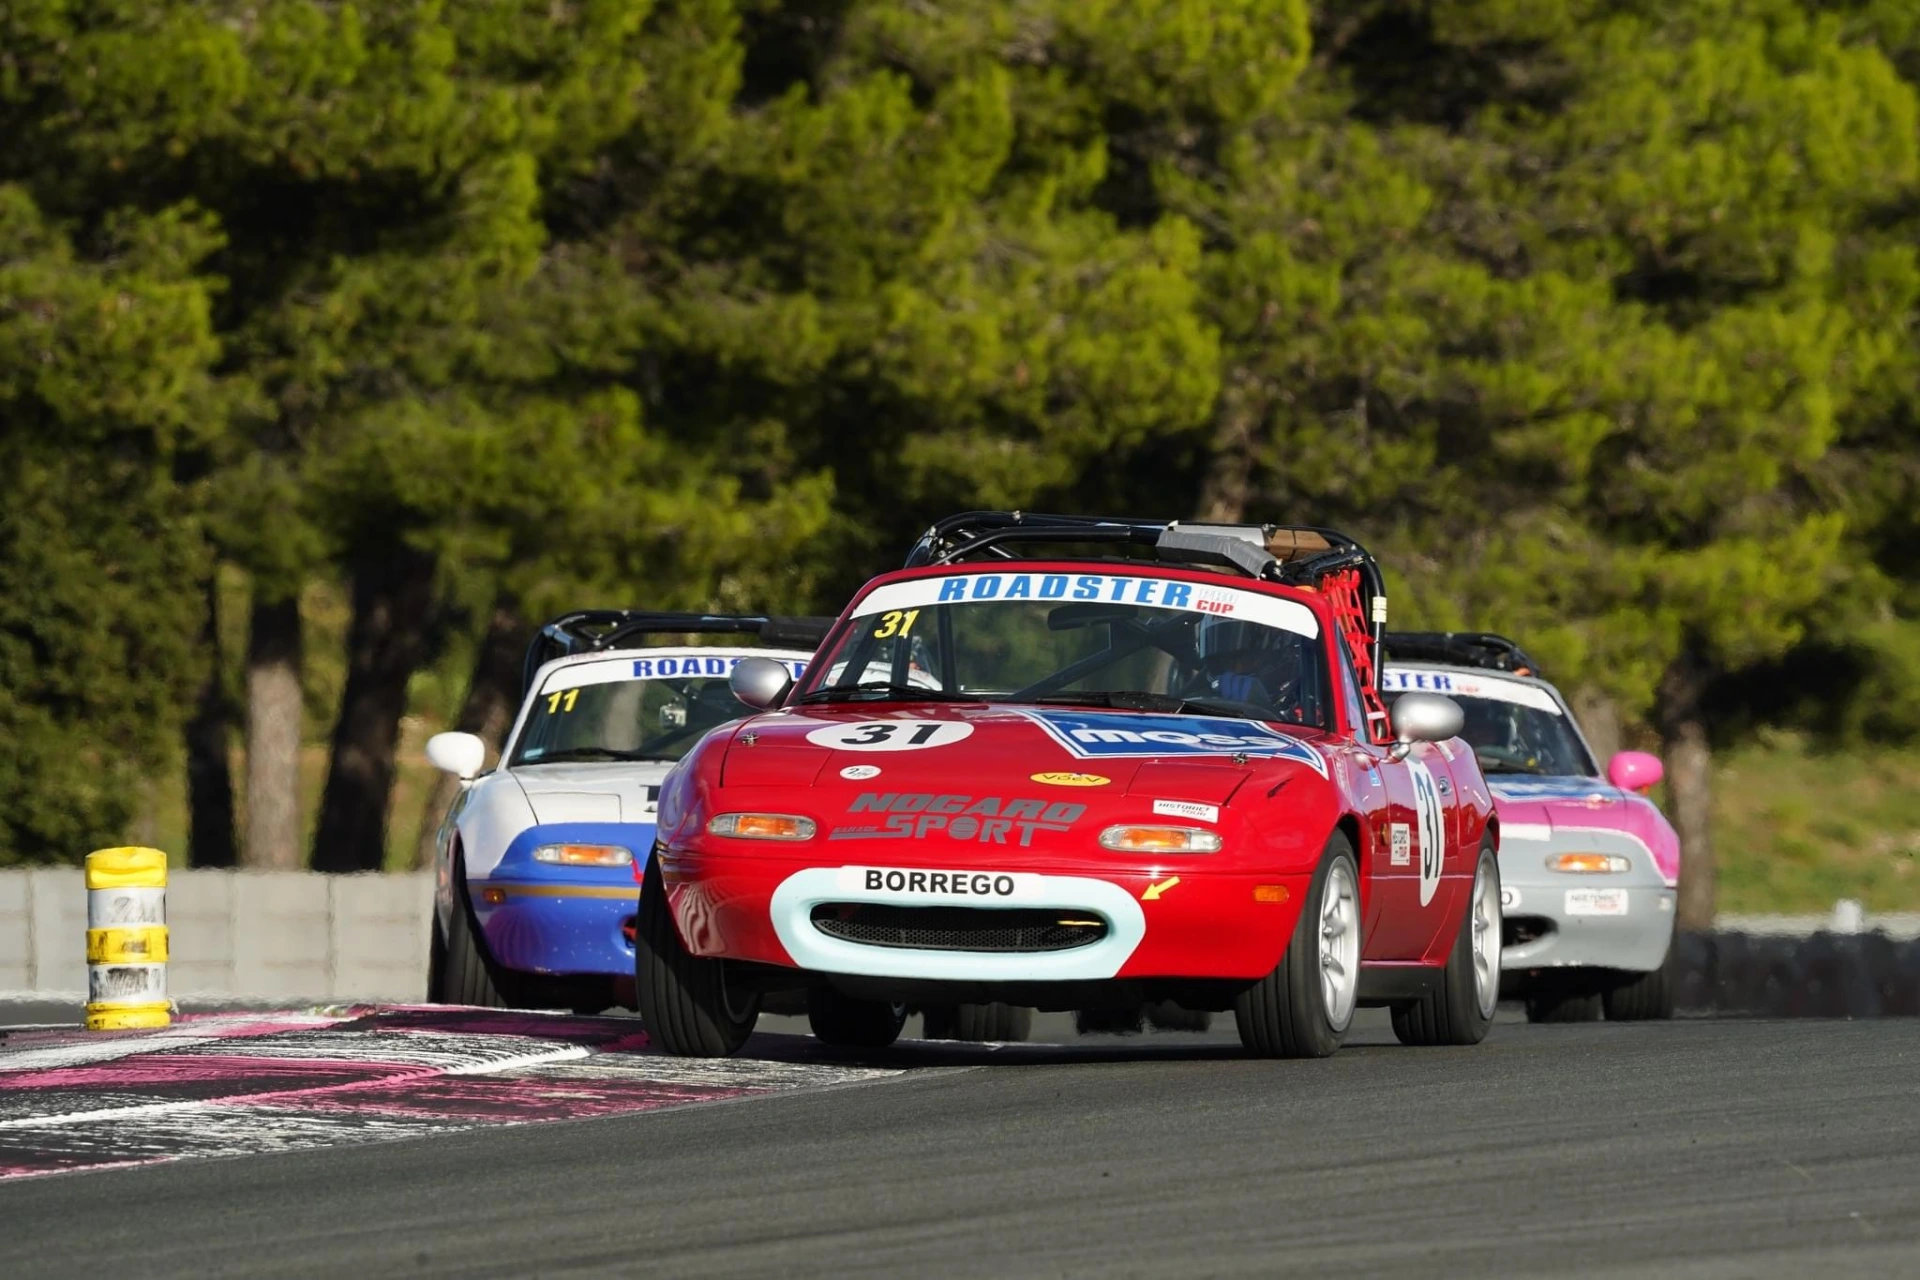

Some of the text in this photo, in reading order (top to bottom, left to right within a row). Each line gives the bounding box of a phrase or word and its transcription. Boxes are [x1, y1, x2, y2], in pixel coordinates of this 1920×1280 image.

[936, 574, 1193, 608] ROADSTER
[1196, 599, 1235, 614] CUP
[873, 609, 920, 639] 31
[547, 689, 579, 715] 11
[840, 724, 943, 745] 31
[846, 792, 1088, 823] NOGARO
[884, 814, 1070, 847] SPORT
[1415, 771, 1440, 880] 31
[865, 869, 1015, 896] BORREGO
